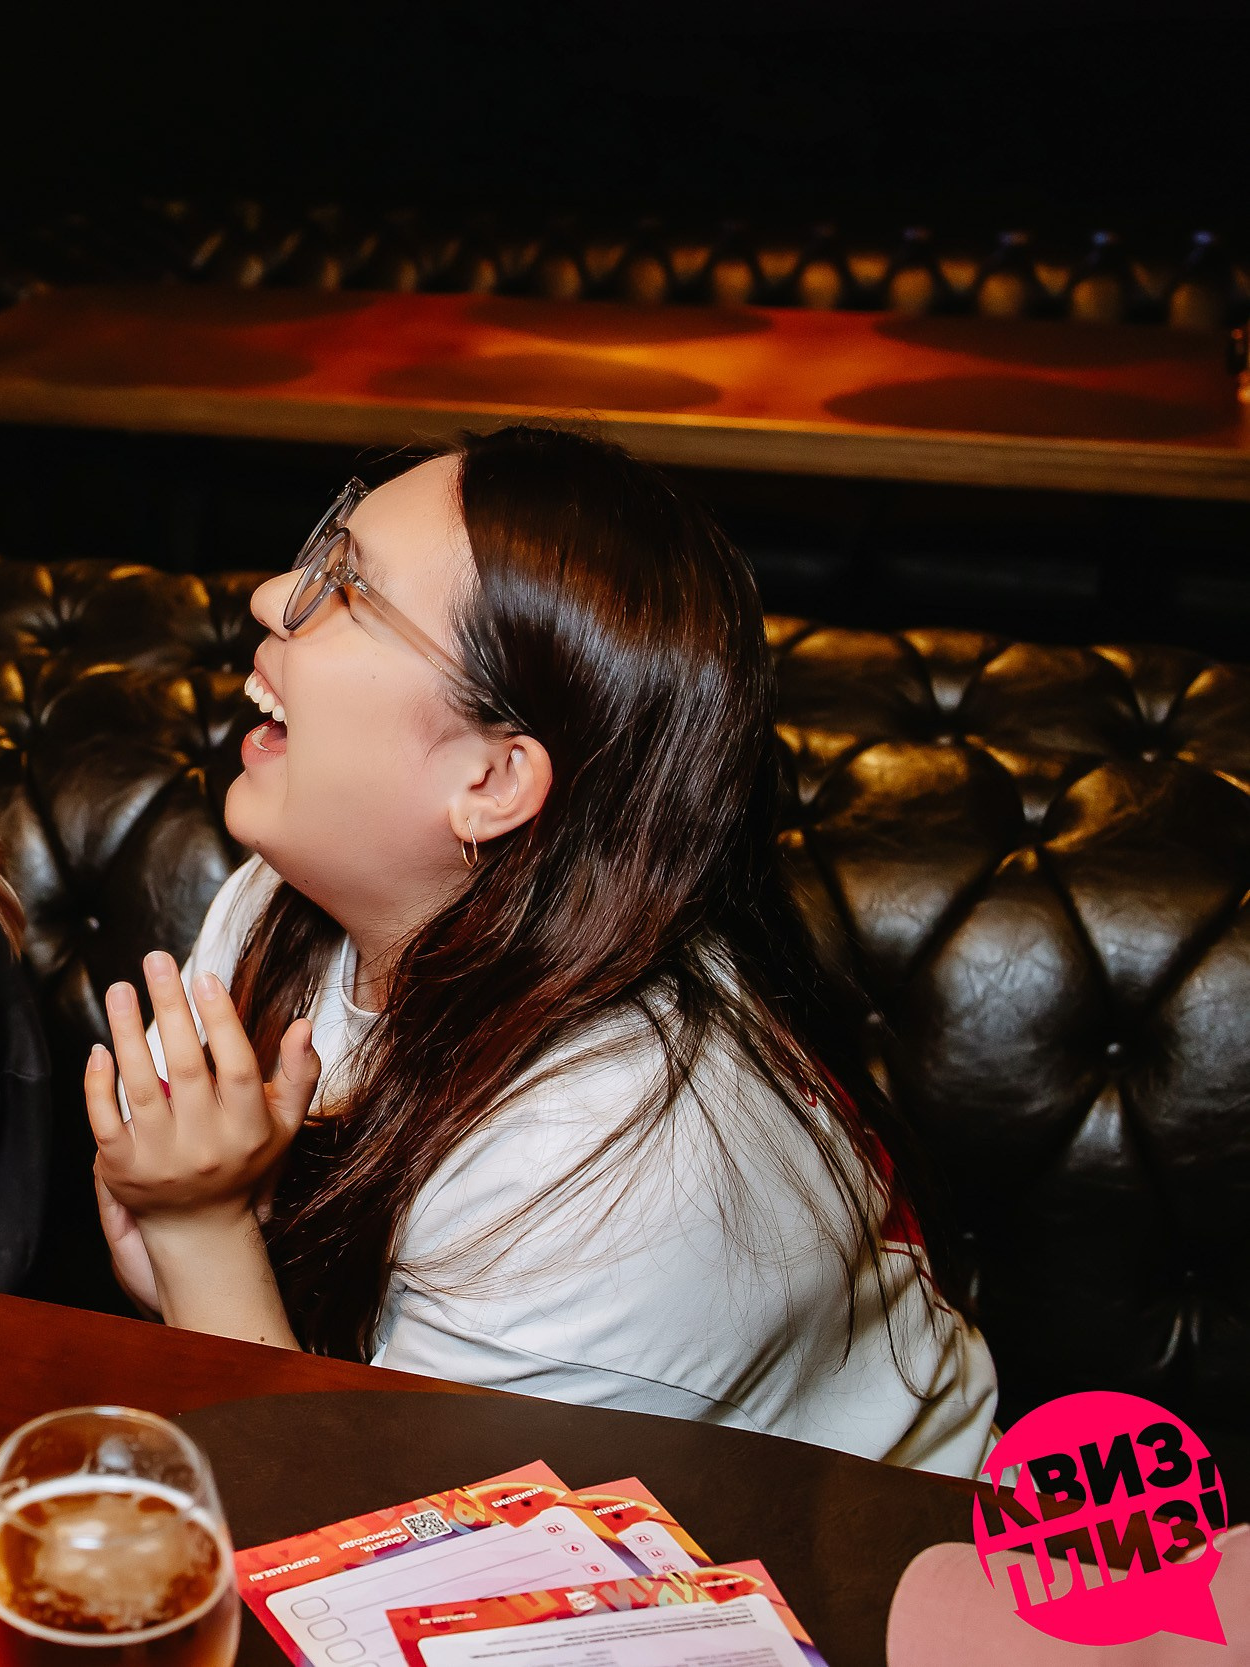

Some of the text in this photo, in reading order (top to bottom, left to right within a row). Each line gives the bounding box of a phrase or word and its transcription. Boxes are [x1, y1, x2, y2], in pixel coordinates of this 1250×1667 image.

[592, 1501, 636, 1518] #КВИЗПЛ
[546, 1524, 564, 1535] 10
[338, 1526, 403, 1552] ПРОМОКОДЫ
[638, 1535, 650, 1544] 12
[248, 1554, 322, 1582] QUIZPLEASE.RU
